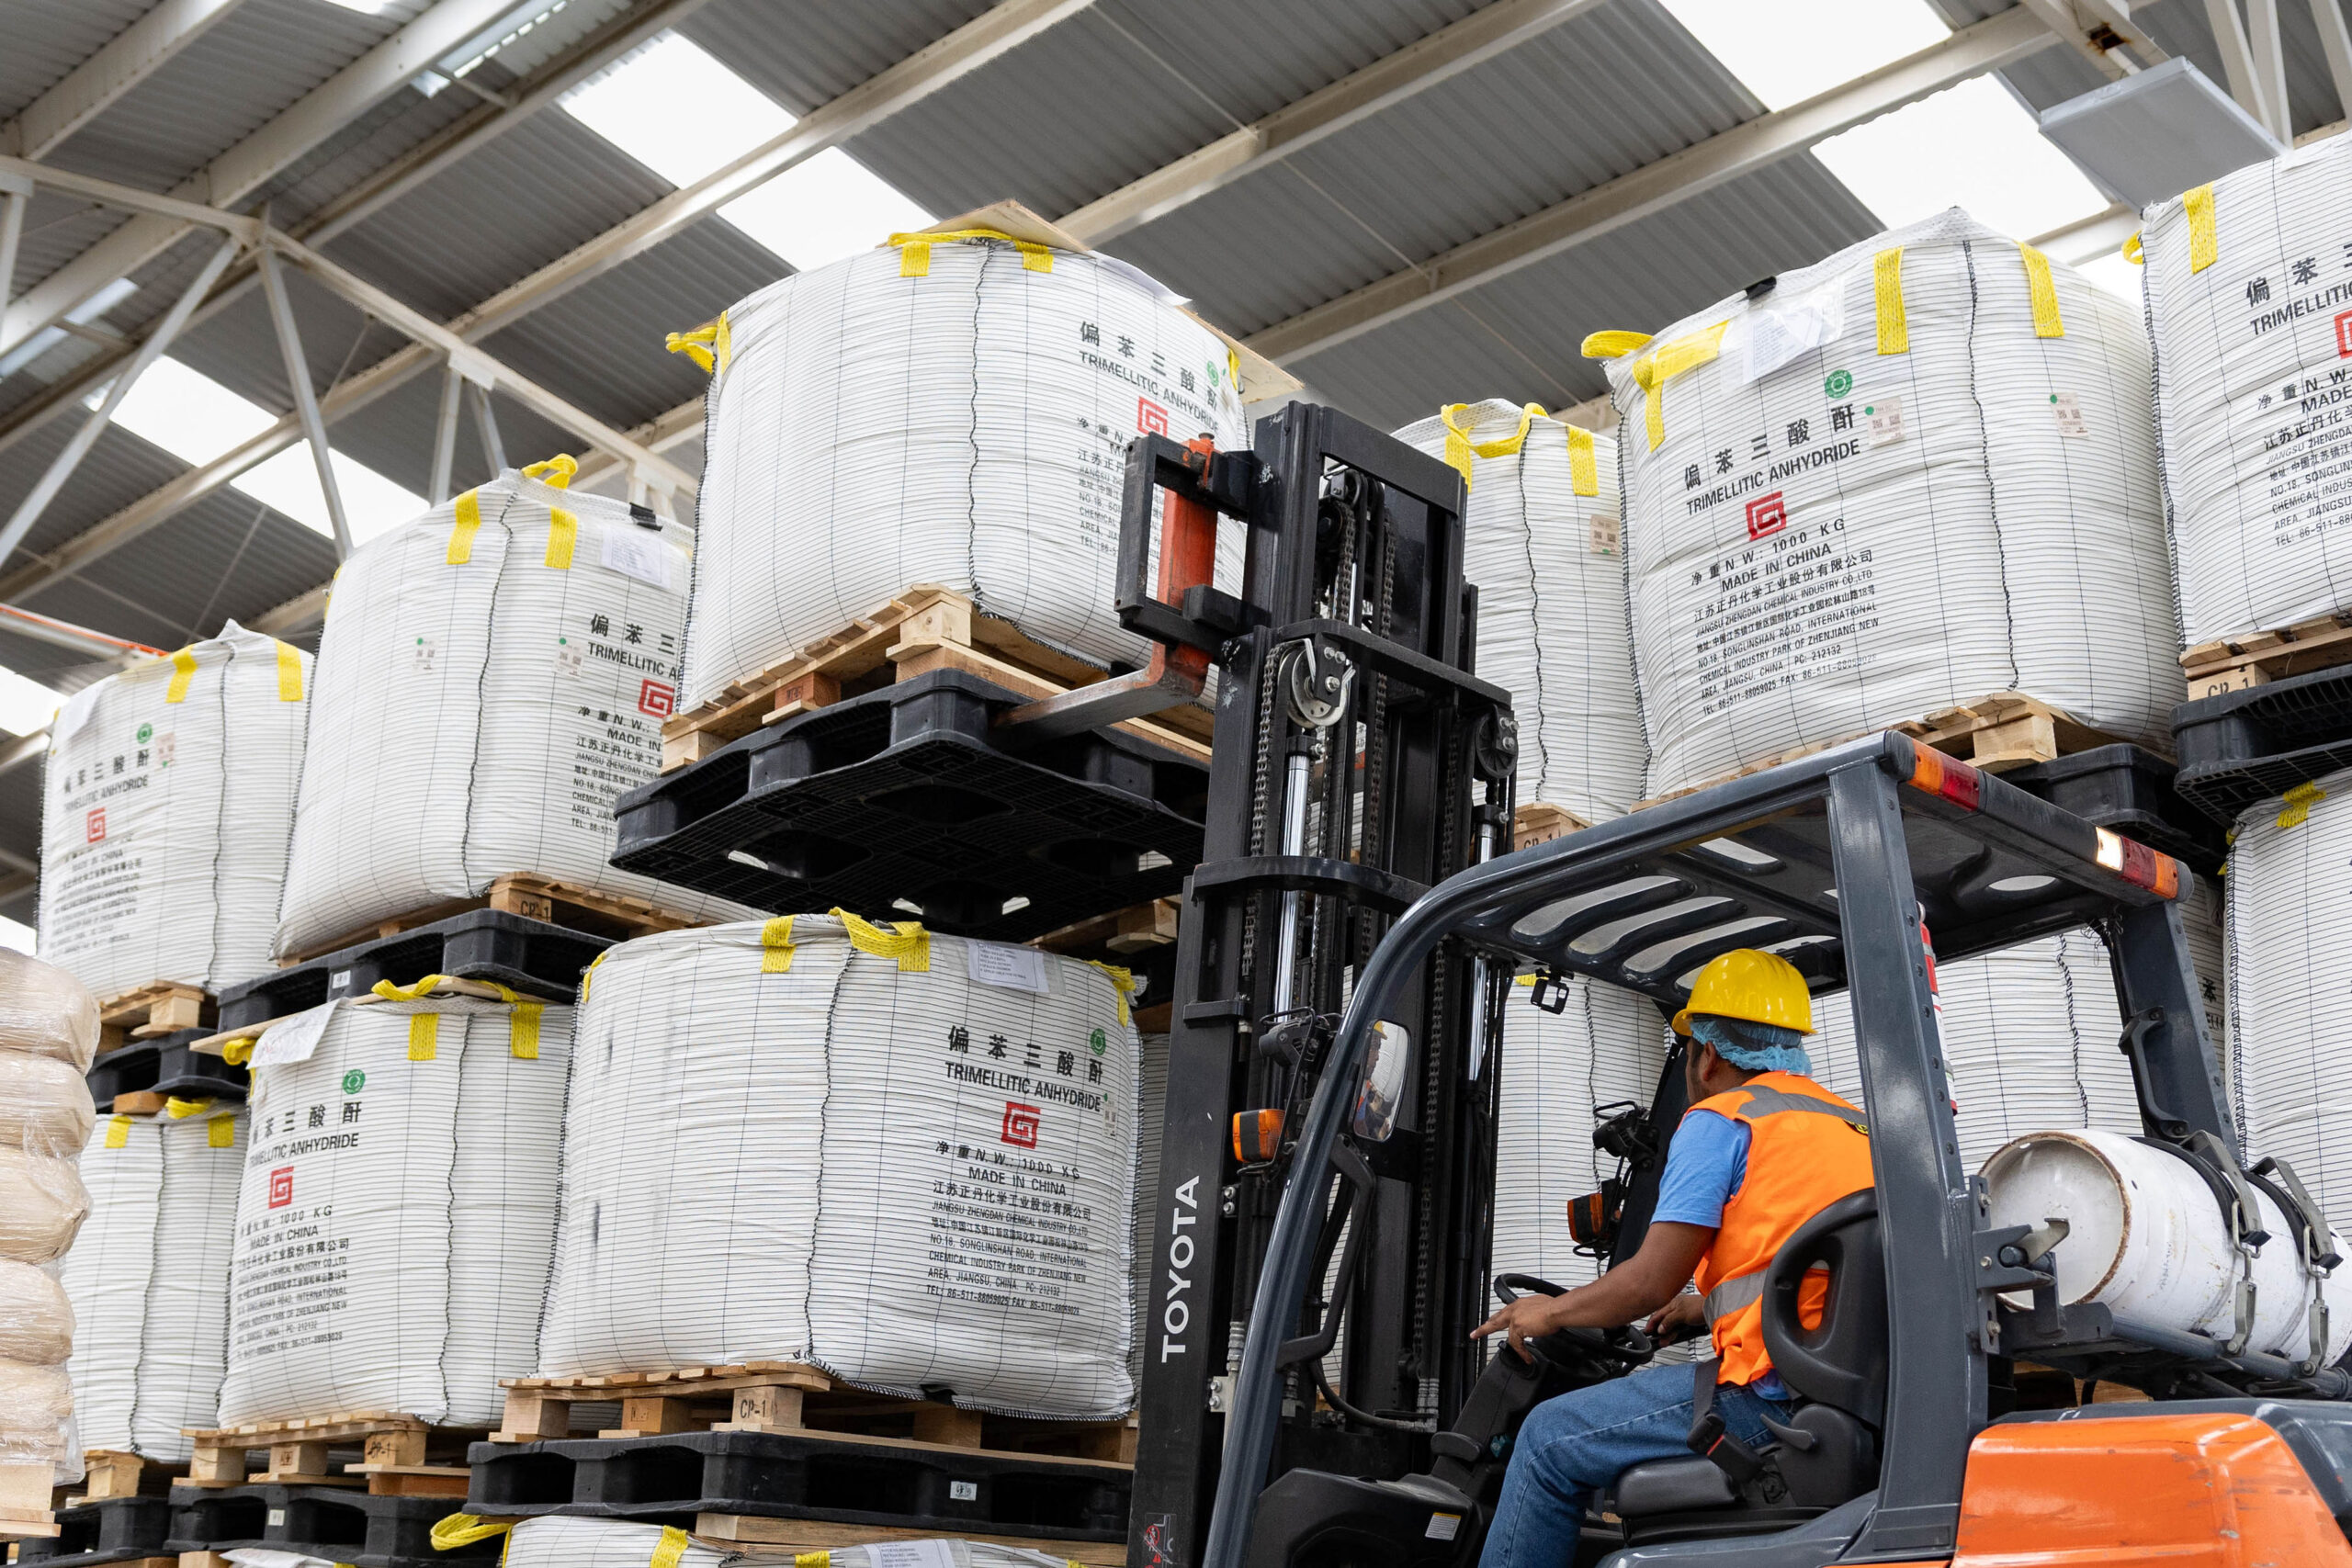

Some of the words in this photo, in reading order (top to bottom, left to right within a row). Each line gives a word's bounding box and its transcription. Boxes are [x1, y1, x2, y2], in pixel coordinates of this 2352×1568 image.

[1080, 321, 1217, 412] 偏苯三酸酐
[1080, 350, 1159, 395] TRIMELLITIC
[1163, 389, 1219, 433] ANHYDRIDE
[2301, 385, 2352, 413] MADE
[1685, 403, 1855, 491] 偏苯三酸酐
[2267, 442, 2304, 465] JIANGSU
[2308, 426, 2352, 448] ZHENGDA
[1687, 471, 1764, 515] TRIMELLITIC
[1770, 438, 1860, 482] ANHYDRIDE
[2272, 489, 2318, 514] CHEMICAL
[1772, 531, 1807, 554] 1000
[1722, 567, 1758, 592] MADE
[1765, 561, 1781, 575] IN
[1786, 543, 1832, 568] CHINA
[1694, 549, 1873, 624] 江苏正丹化学工业股份有限公司
[1695, 617, 1724, 637] JIANGSU
[1725, 605, 1761, 626] ZHENGDAN
[1764, 592, 1798, 612] CHEMICAL
[1801, 580, 1838, 599] INDUSTRY
[591, 614, 675, 656] 偏苯三
[1722, 631, 1775, 660] SONGLINSHAN
[1807, 602, 1877, 629] INTERNATIONAL
[588, 641, 664, 676] TRIMELLITIC
[1699, 663, 1731, 685] CHEMICAL
[1734, 650, 1770, 671] INDUSTRY
[1772, 643, 1792, 658] PARK
[1794, 637, 1804, 650] OF
[1808, 623, 1856, 646] ZHENJIANG
[1859, 617, 1880, 631] NEW
[1811, 644, 1841, 661] 212132
[1718, 680, 1777, 709] 86-511-88059025
[607, 728, 642, 747] MADE
[649, 739, 661, 751] IN
[575, 751, 604, 766] JIANGSU
[606, 756, 640, 775] ZHENGDAN
[101, 774, 148, 799] ANHYDRIDE
[572, 791, 605, 807] CHEMICAL
[597, 809, 616, 822] JIANG
[948, 1025, 1102, 1085] 偏苯三酸酐
[945, 1061, 1030, 1095] TRIMELLITIC
[1035, 1080, 1101, 1112] ANHYDRIDE
[290, 1133, 359, 1156] ANHYDRIDE
[968, 1166, 1005, 1185] MADE
[1012, 1174, 1025, 1189] IN
[1032, 1178, 1067, 1196] CHINA
[1022, 1158, 1053, 1174] 1000
[933, 1179, 1091, 1222] 江苏正丹化学工业股份有限公司
[932, 1201, 964, 1214] JIANGSU
[967, 1205, 1003, 1224] ZHENGDAN
[1005, 1213, 1035, 1226] CHEMICAL
[1038, 1218, 1067, 1232] INDUSTRY
[287, 1225, 319, 1241] CHINA
[294, 1261, 321, 1272] INDUSTRY
[929, 1250, 967, 1266] CHEMICAL
[970, 1257, 1006, 1271] INDUSTRY
[1008, 1263, 1024, 1274] PARK
[1027, 1265, 1036, 1276] OF
[1038, 1268, 1071, 1281] ZHENJIANG
[1074, 1272, 1086, 1283] NEW
[959, 1238, 1013, 1257] SONGLINSHAN
[1040, 1250, 1087, 1268] INTERNATIONAL
[1161, 1176, 1199, 1363] TOYOTA
[297, 1287, 347, 1302] INTERNATIONAL
[946, 1287, 1009, 1306] 86-511-88059025
[1039, 1284, 1060, 1297] 212132
[741, 1399, 766, 1419] CP-1
